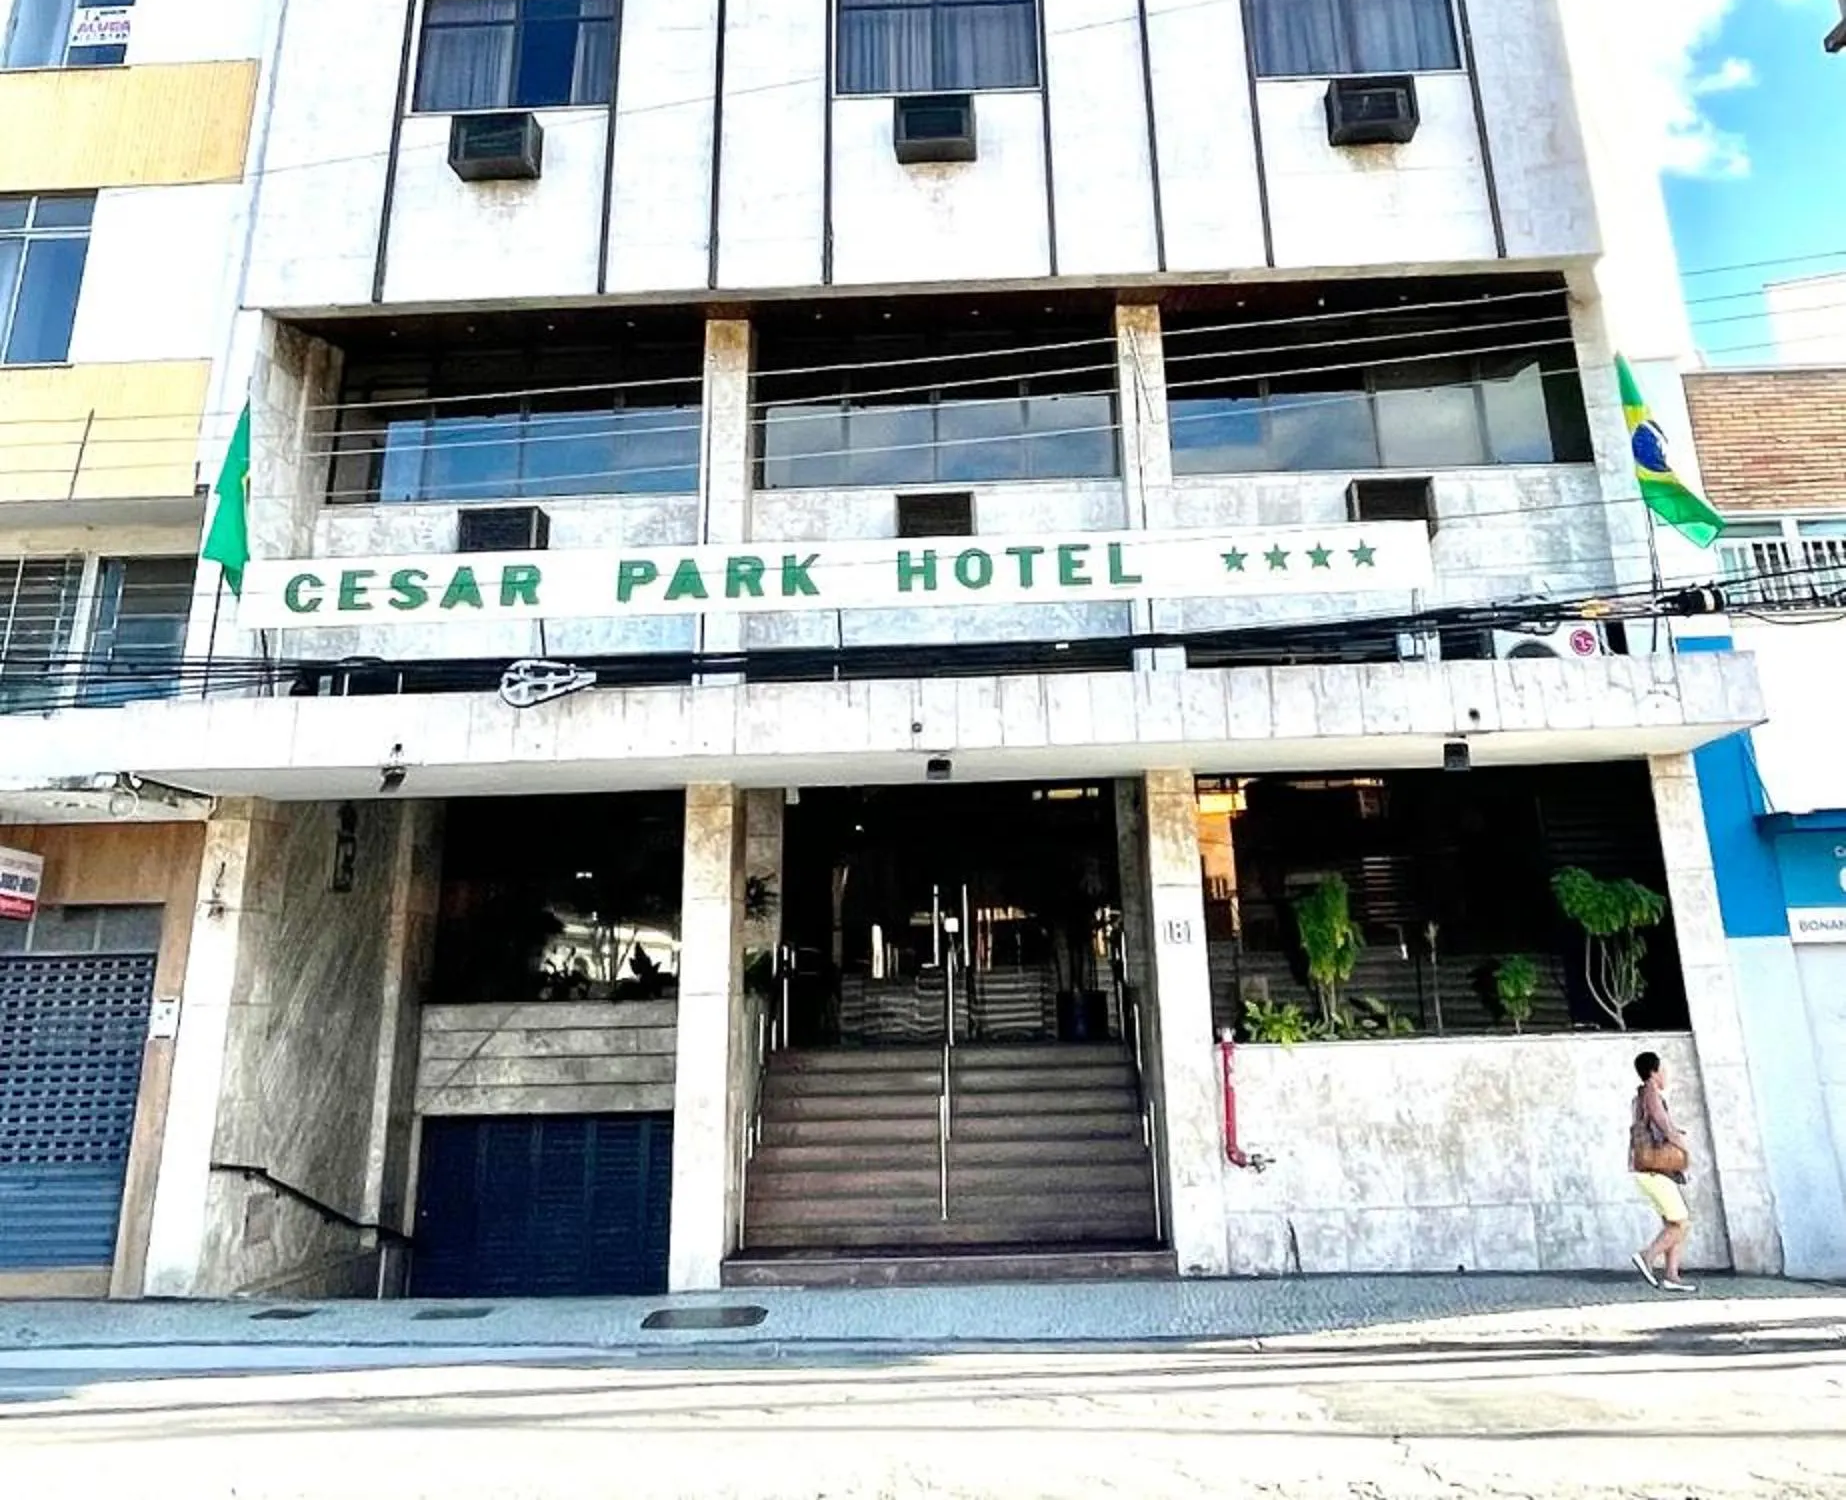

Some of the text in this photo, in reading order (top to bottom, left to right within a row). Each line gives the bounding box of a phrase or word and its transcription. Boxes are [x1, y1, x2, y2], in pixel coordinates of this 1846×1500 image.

[285, 542, 1143, 613] CESAR PARK HOTEL
[1162, 918, 1192, 945] 181
